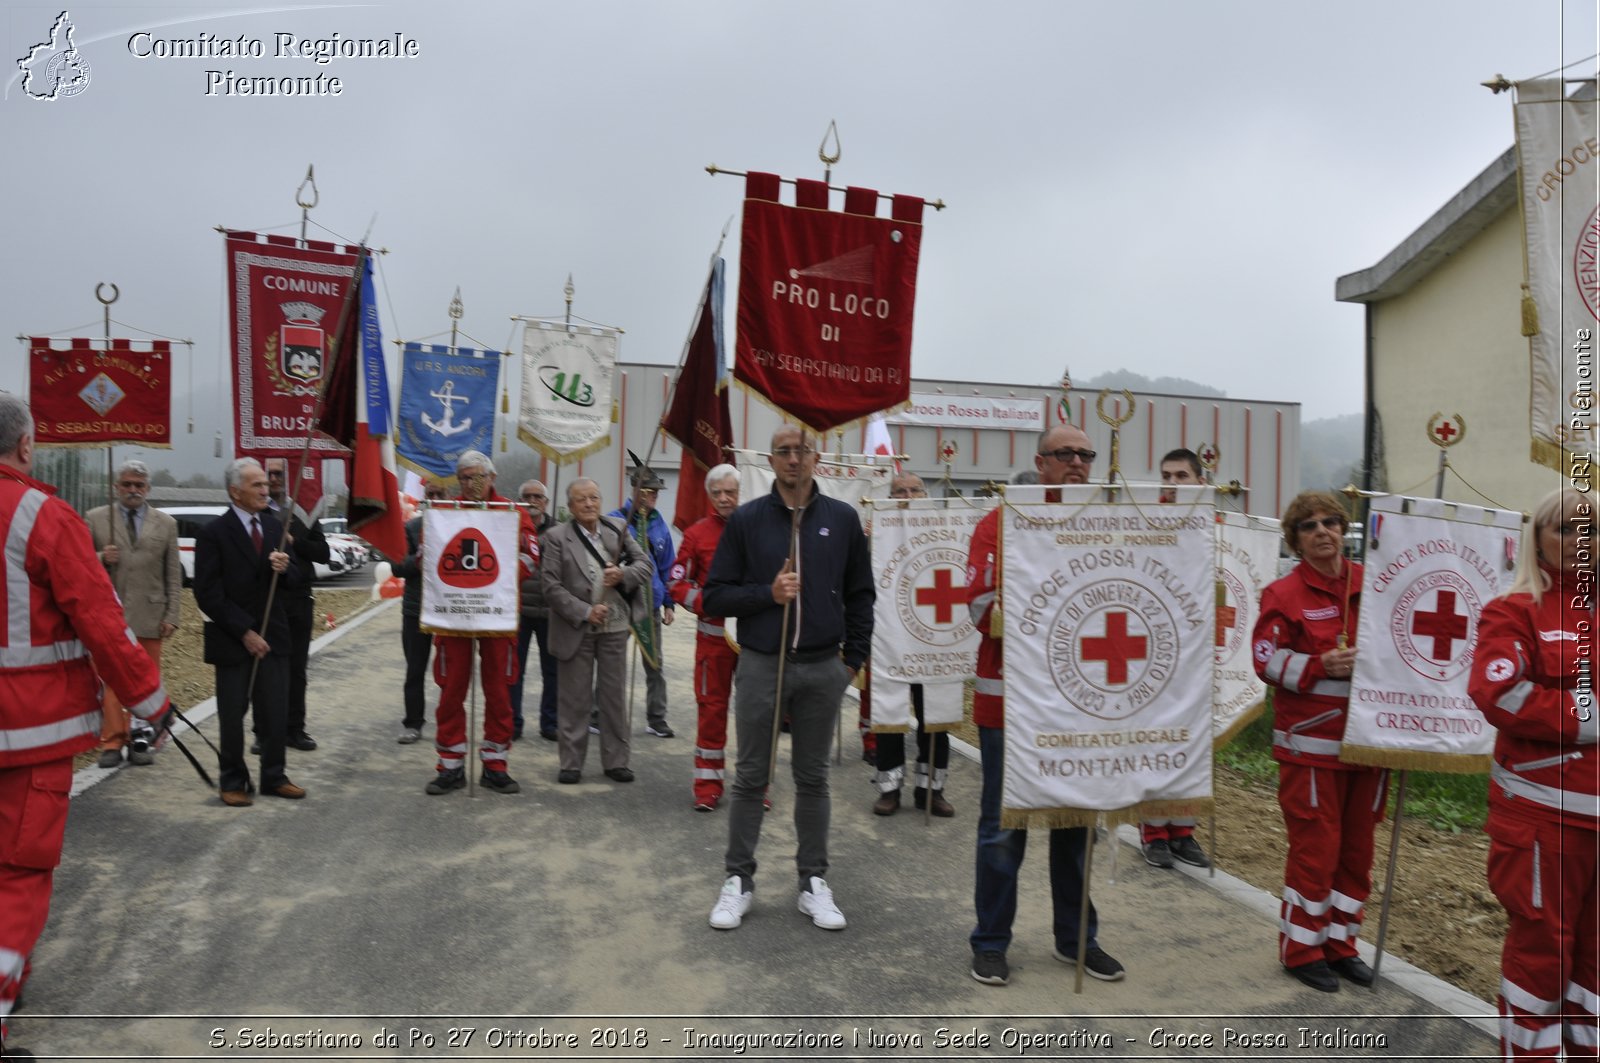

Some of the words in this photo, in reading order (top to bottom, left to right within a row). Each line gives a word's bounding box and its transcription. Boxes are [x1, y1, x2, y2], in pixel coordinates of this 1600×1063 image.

[1536, 136, 1600, 202] CROCE
[263, 275, 340, 297] COMUNE
[772, 280, 820, 308] PRO
[829, 292, 890, 319] LOCO
[821, 323, 840, 342] DI
[93, 356, 160, 390] COMUNALE
[752, 348, 774, 367] SAN
[777, 353, 861, 383] SEBASTIANO
[865, 367, 883, 383] DA
[302, 404, 314, 413] DI
[904, 402, 944, 416] Croce
[947, 404, 989, 419] Rossa
[992, 407, 1040, 421] Italiana
[56, 421, 143, 434] SEBASTIANO
[145, 424, 166, 435] PO
[1013, 514, 1059, 531] CORPO
[1059, 515, 1120, 532] VOLONTARI
[1123, 516, 1142, 531] DEL
[1148, 515, 1207, 531] SOCCORSO
[1056, 534, 1113, 545] GRUPPO
[1123, 534, 1178, 546] PIONIERI
[880, 544, 911, 589] CROCE
[909, 529, 957, 549] ROSSA
[1372, 548, 1418, 594] CROCE
[1417, 539, 1458, 558] ROSSA
[1019, 568, 1069, 636] CROCE
[1068, 549, 1136, 577] ROSSA
[1141, 556, 1206, 631] ITALIANA
[1082, 583, 1141, 608] GINEVRA
[1065, 602, 1084, 621] DI
[1141, 600, 1162, 620] 22
[903, 652, 971, 663] POSTAZIONE
[1149, 622, 1174, 681] AGOSTO
[1053, 620, 1106, 712] CONVENZIONE
[1358, 689, 1440, 709] COMITATO
[1441, 696, 1479, 711] LOCAL
[1375, 711, 1483, 736] CRESCENTINO
[1036, 733, 1122, 748] COMITATO
[1128, 728, 1190, 744] LOCALE
[1038, 752, 1188, 777] MONTANARO
